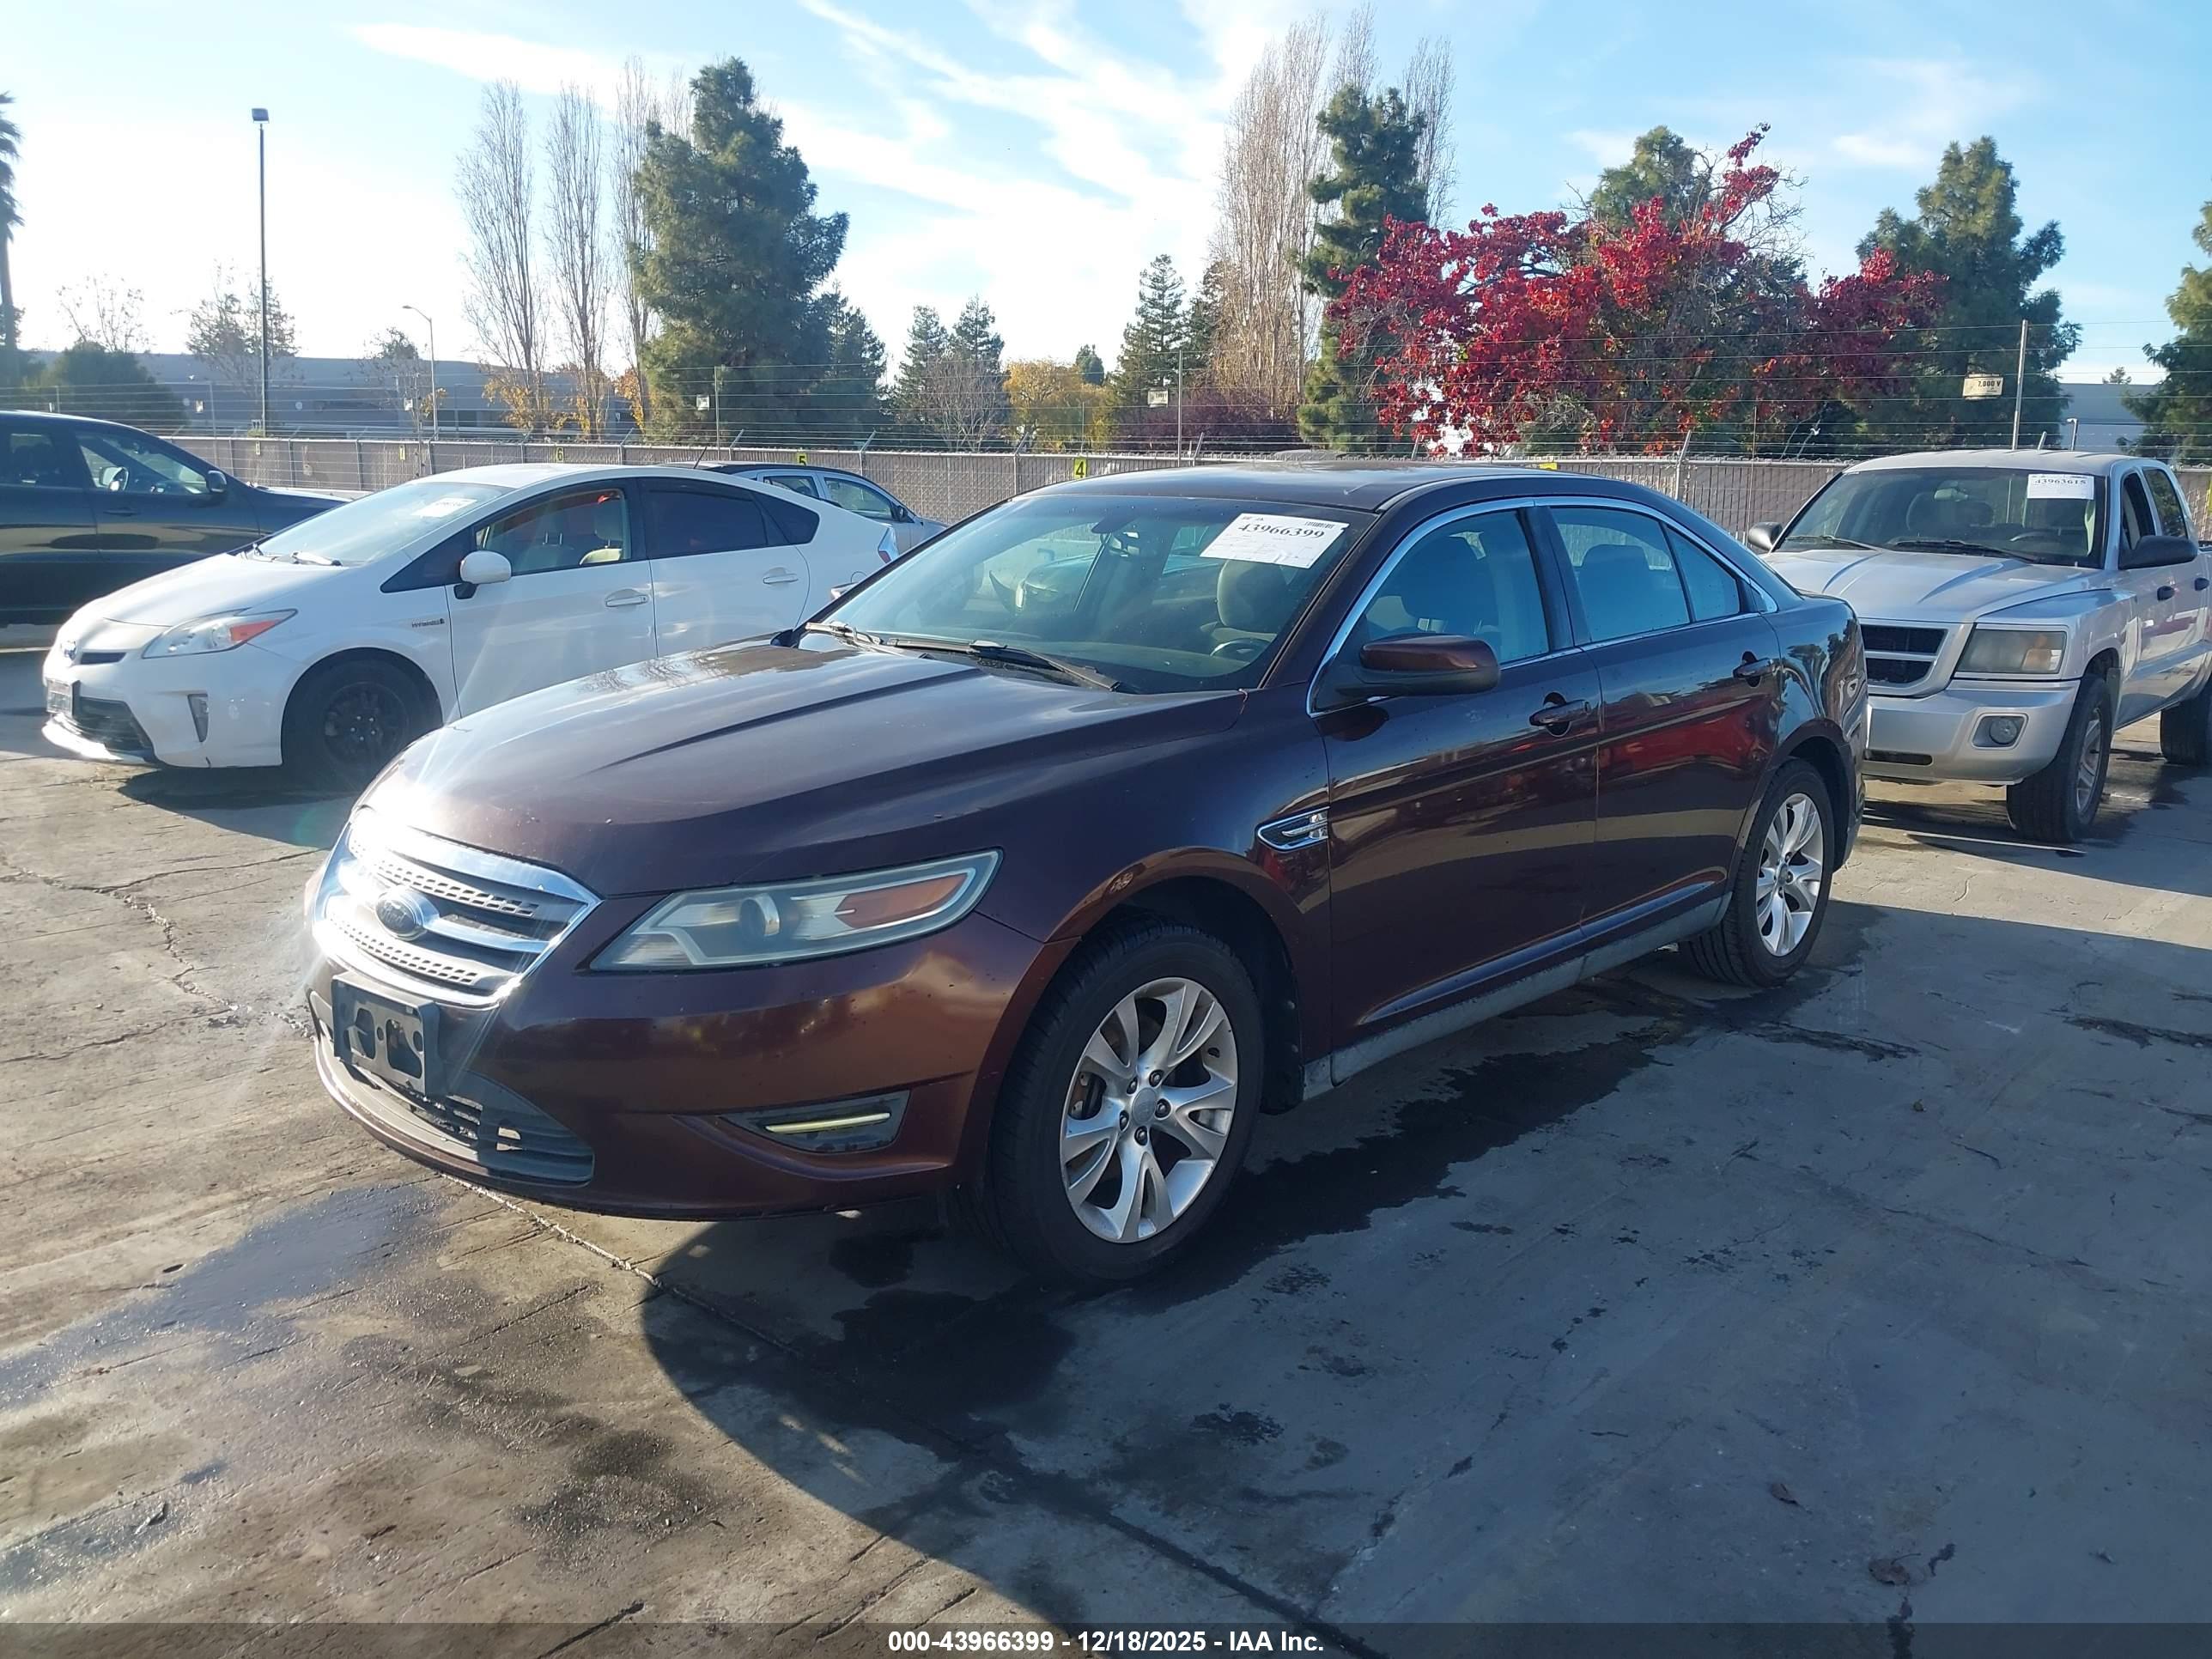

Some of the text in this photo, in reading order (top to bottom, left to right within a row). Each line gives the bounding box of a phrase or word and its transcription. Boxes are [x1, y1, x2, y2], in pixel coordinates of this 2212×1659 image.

[558, 447, 563, 461] 6
[799, 455, 806, 466] 5
[1075, 461, 1085, 478] 4
[1238, 523, 1324, 538] 43966399
